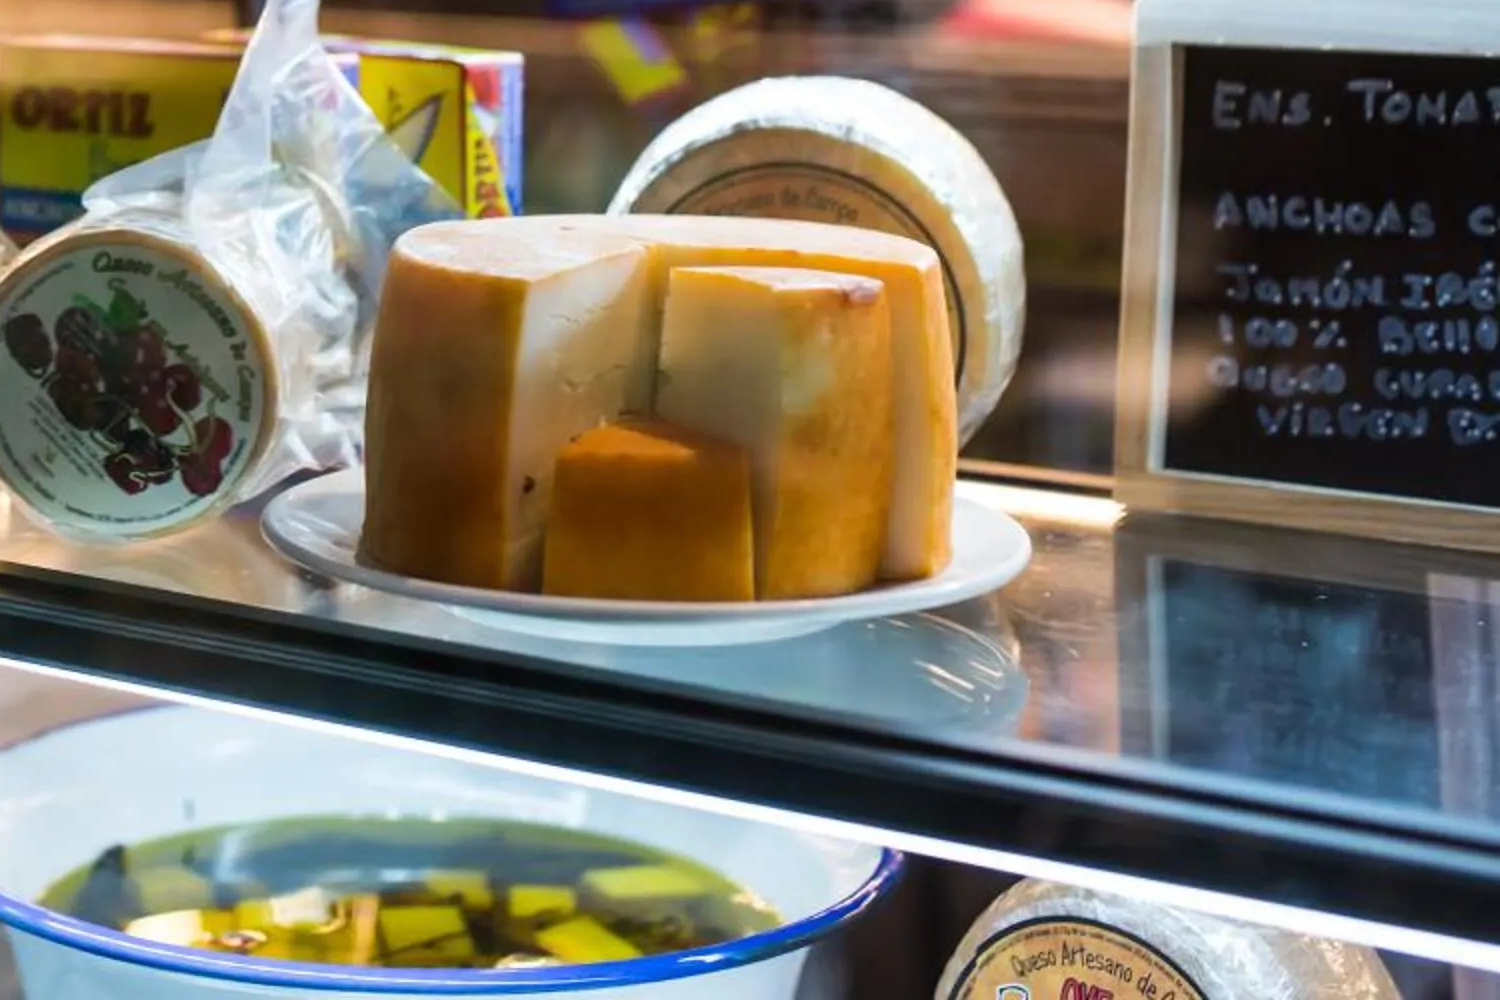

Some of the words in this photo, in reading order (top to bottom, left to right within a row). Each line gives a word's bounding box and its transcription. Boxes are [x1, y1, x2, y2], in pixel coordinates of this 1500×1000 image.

[11, 86, 157, 138] ORTIZ
[1214, 191, 1436, 238] ANCHOAS
[1010, 950, 1056, 977] Queso
[1061, 940, 1133, 983] Artesano
